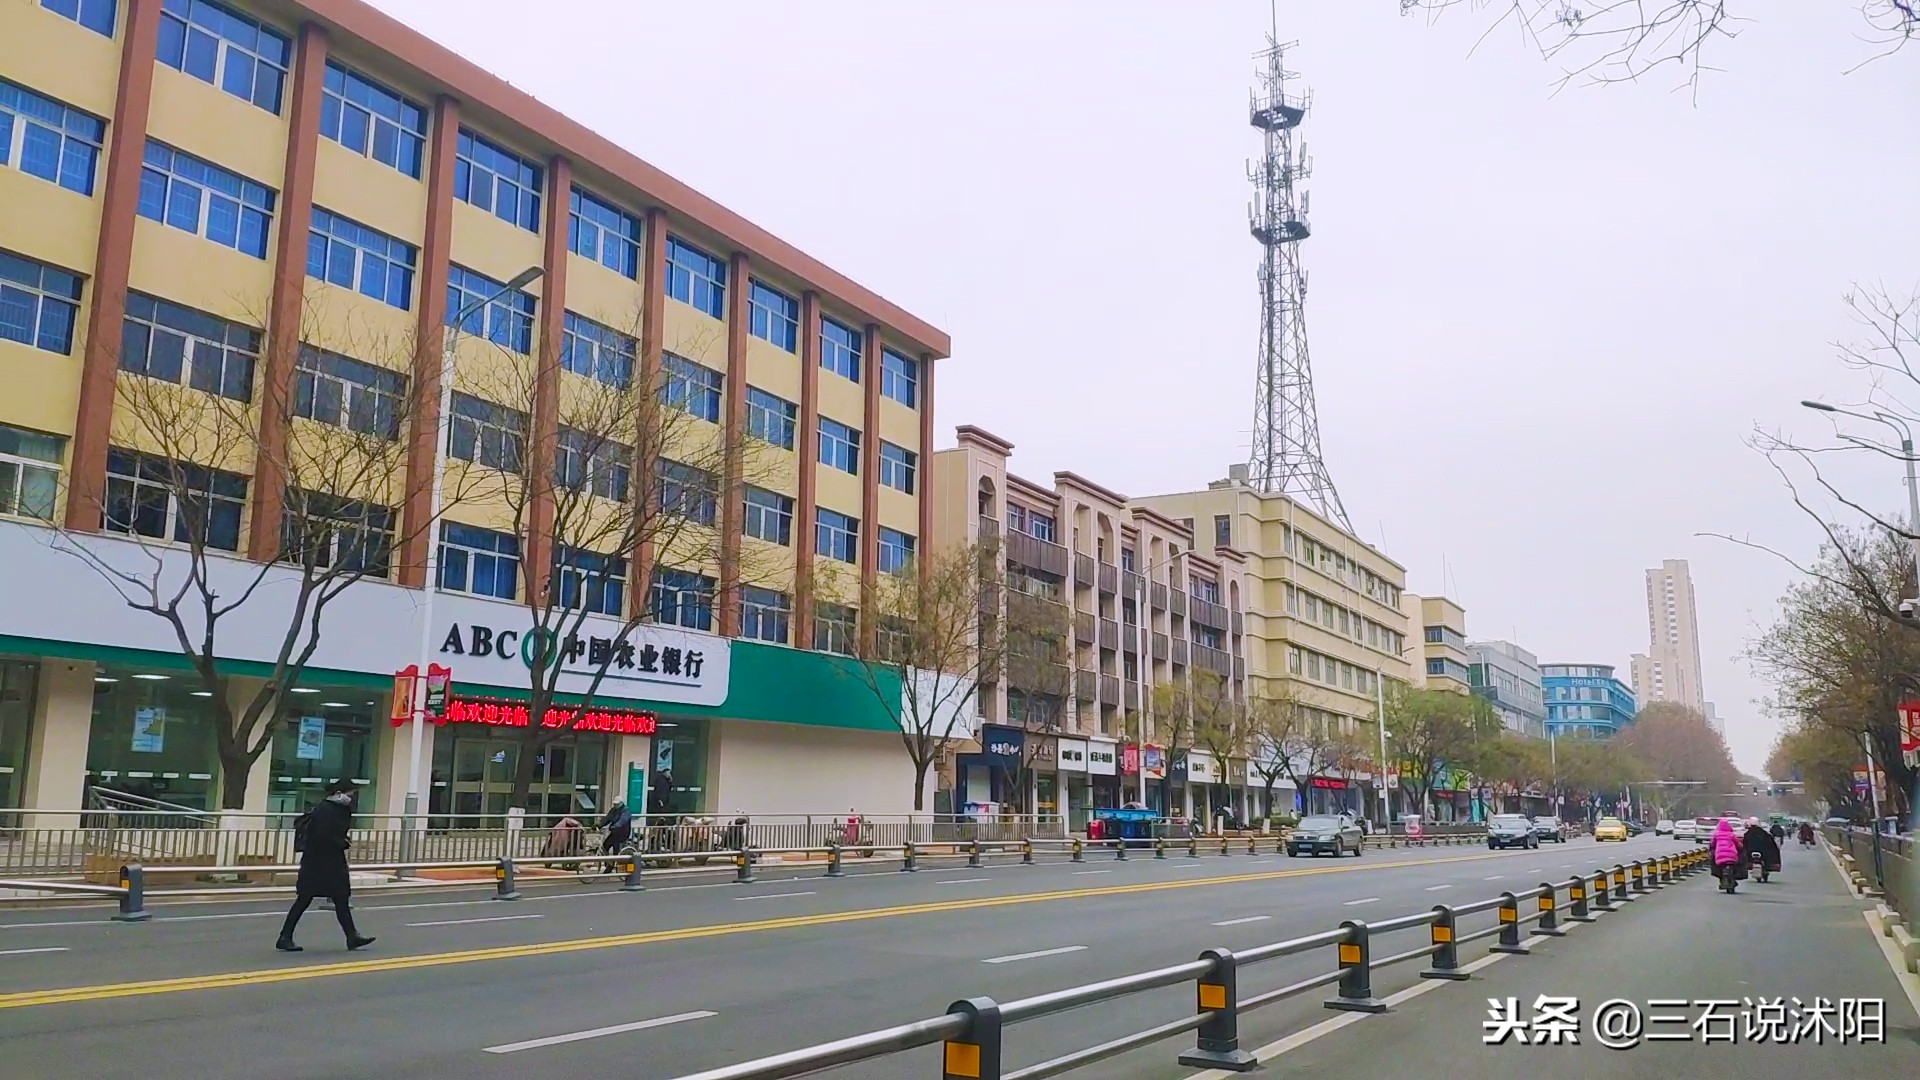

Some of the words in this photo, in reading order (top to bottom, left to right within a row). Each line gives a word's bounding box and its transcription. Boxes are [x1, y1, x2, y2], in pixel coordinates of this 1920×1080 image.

[440, 622, 518, 660] ABC
[562, 633, 704, 679] 中国农业银行
